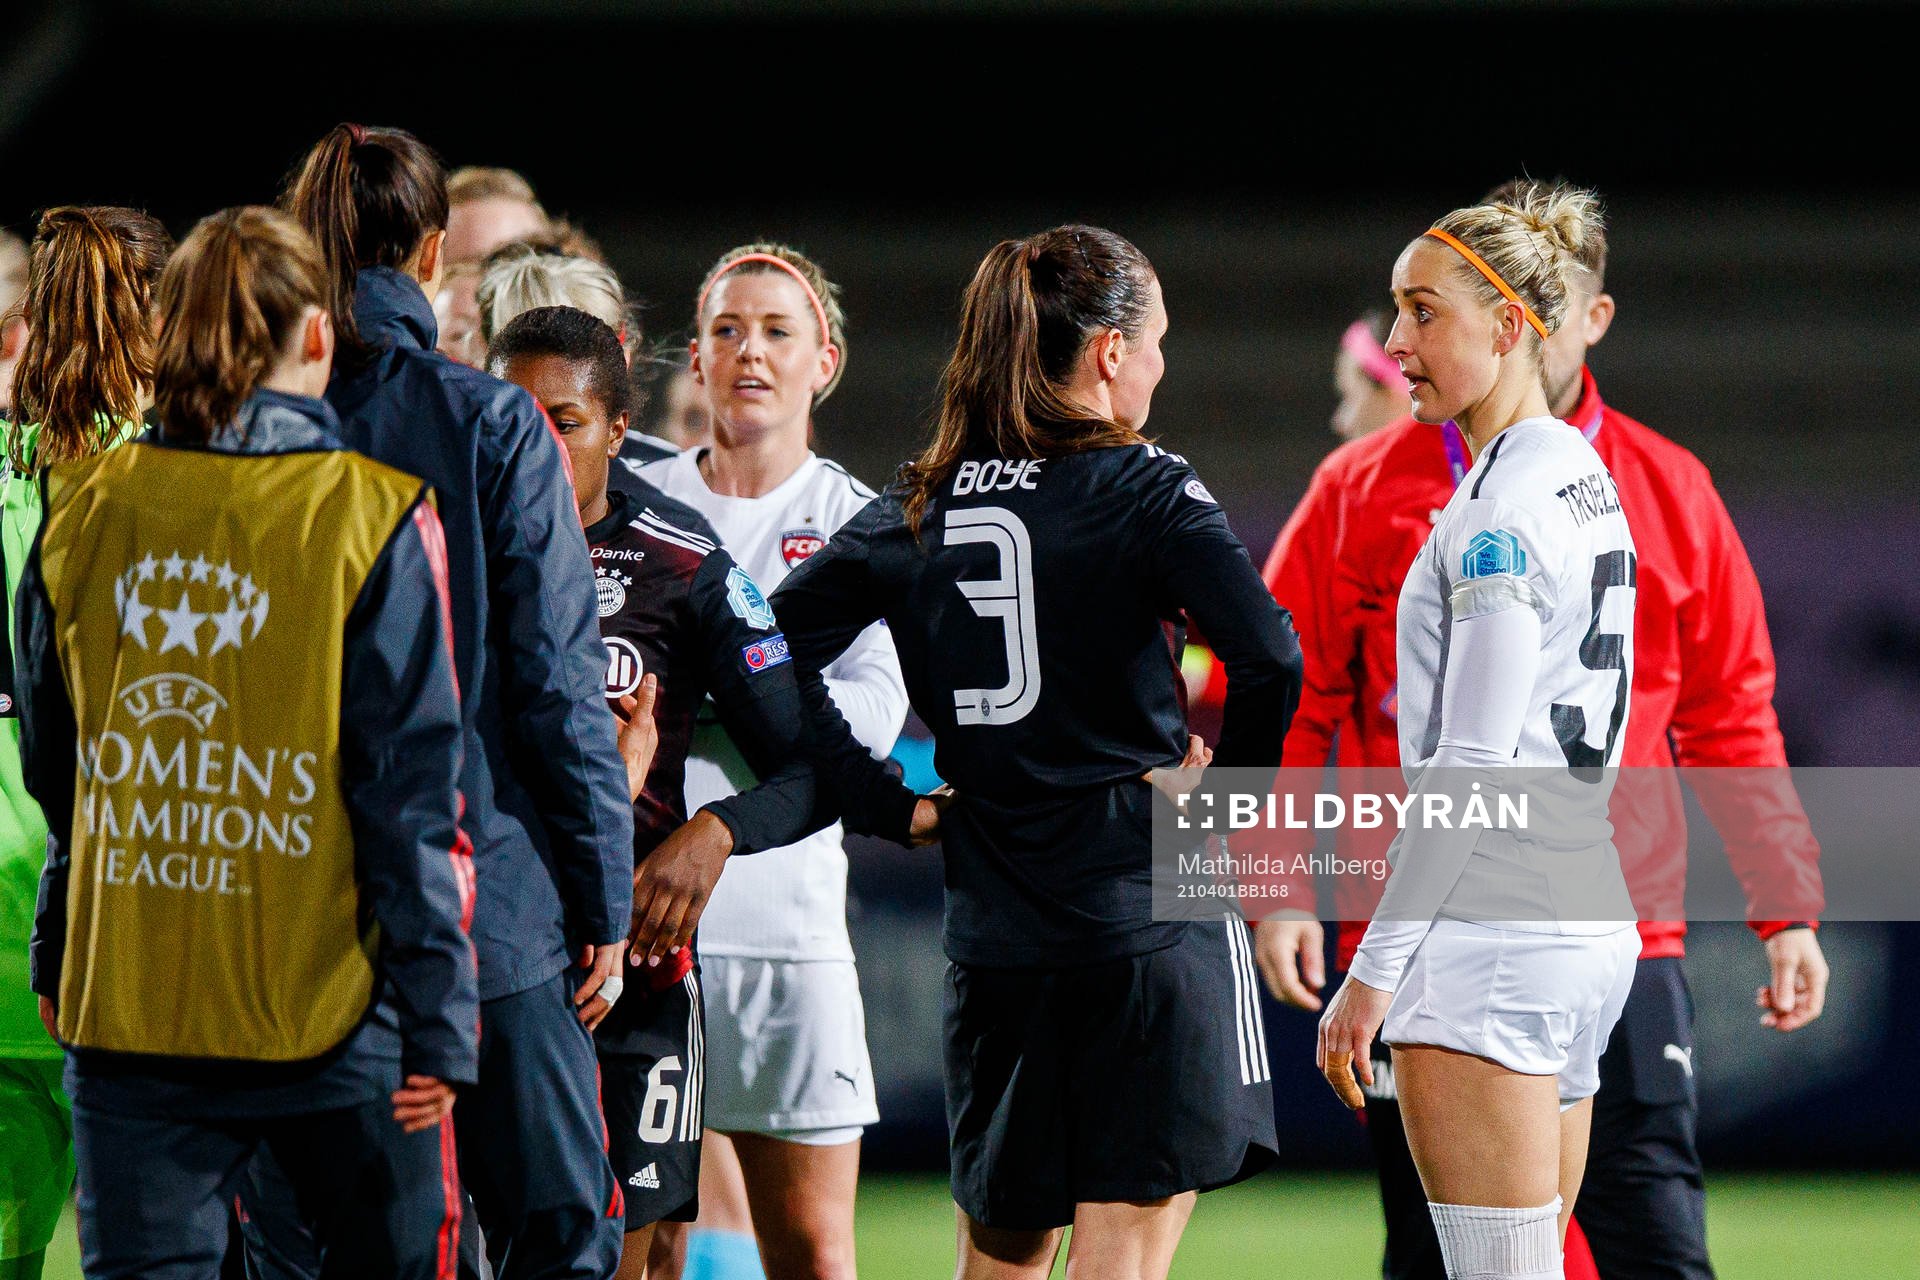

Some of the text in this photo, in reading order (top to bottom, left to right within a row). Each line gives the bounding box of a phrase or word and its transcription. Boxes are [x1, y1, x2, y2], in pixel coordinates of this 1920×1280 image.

[952, 458, 1047, 496] BOYE
[590, 547, 645, 560] Danke
[1480, 559, 1497, 568] Play
[596, 580, 621, 596] BAYERN
[944, 506, 1041, 726] 3
[124, 681, 217, 726] UEFA
[637, 1055, 682, 1144] 6
